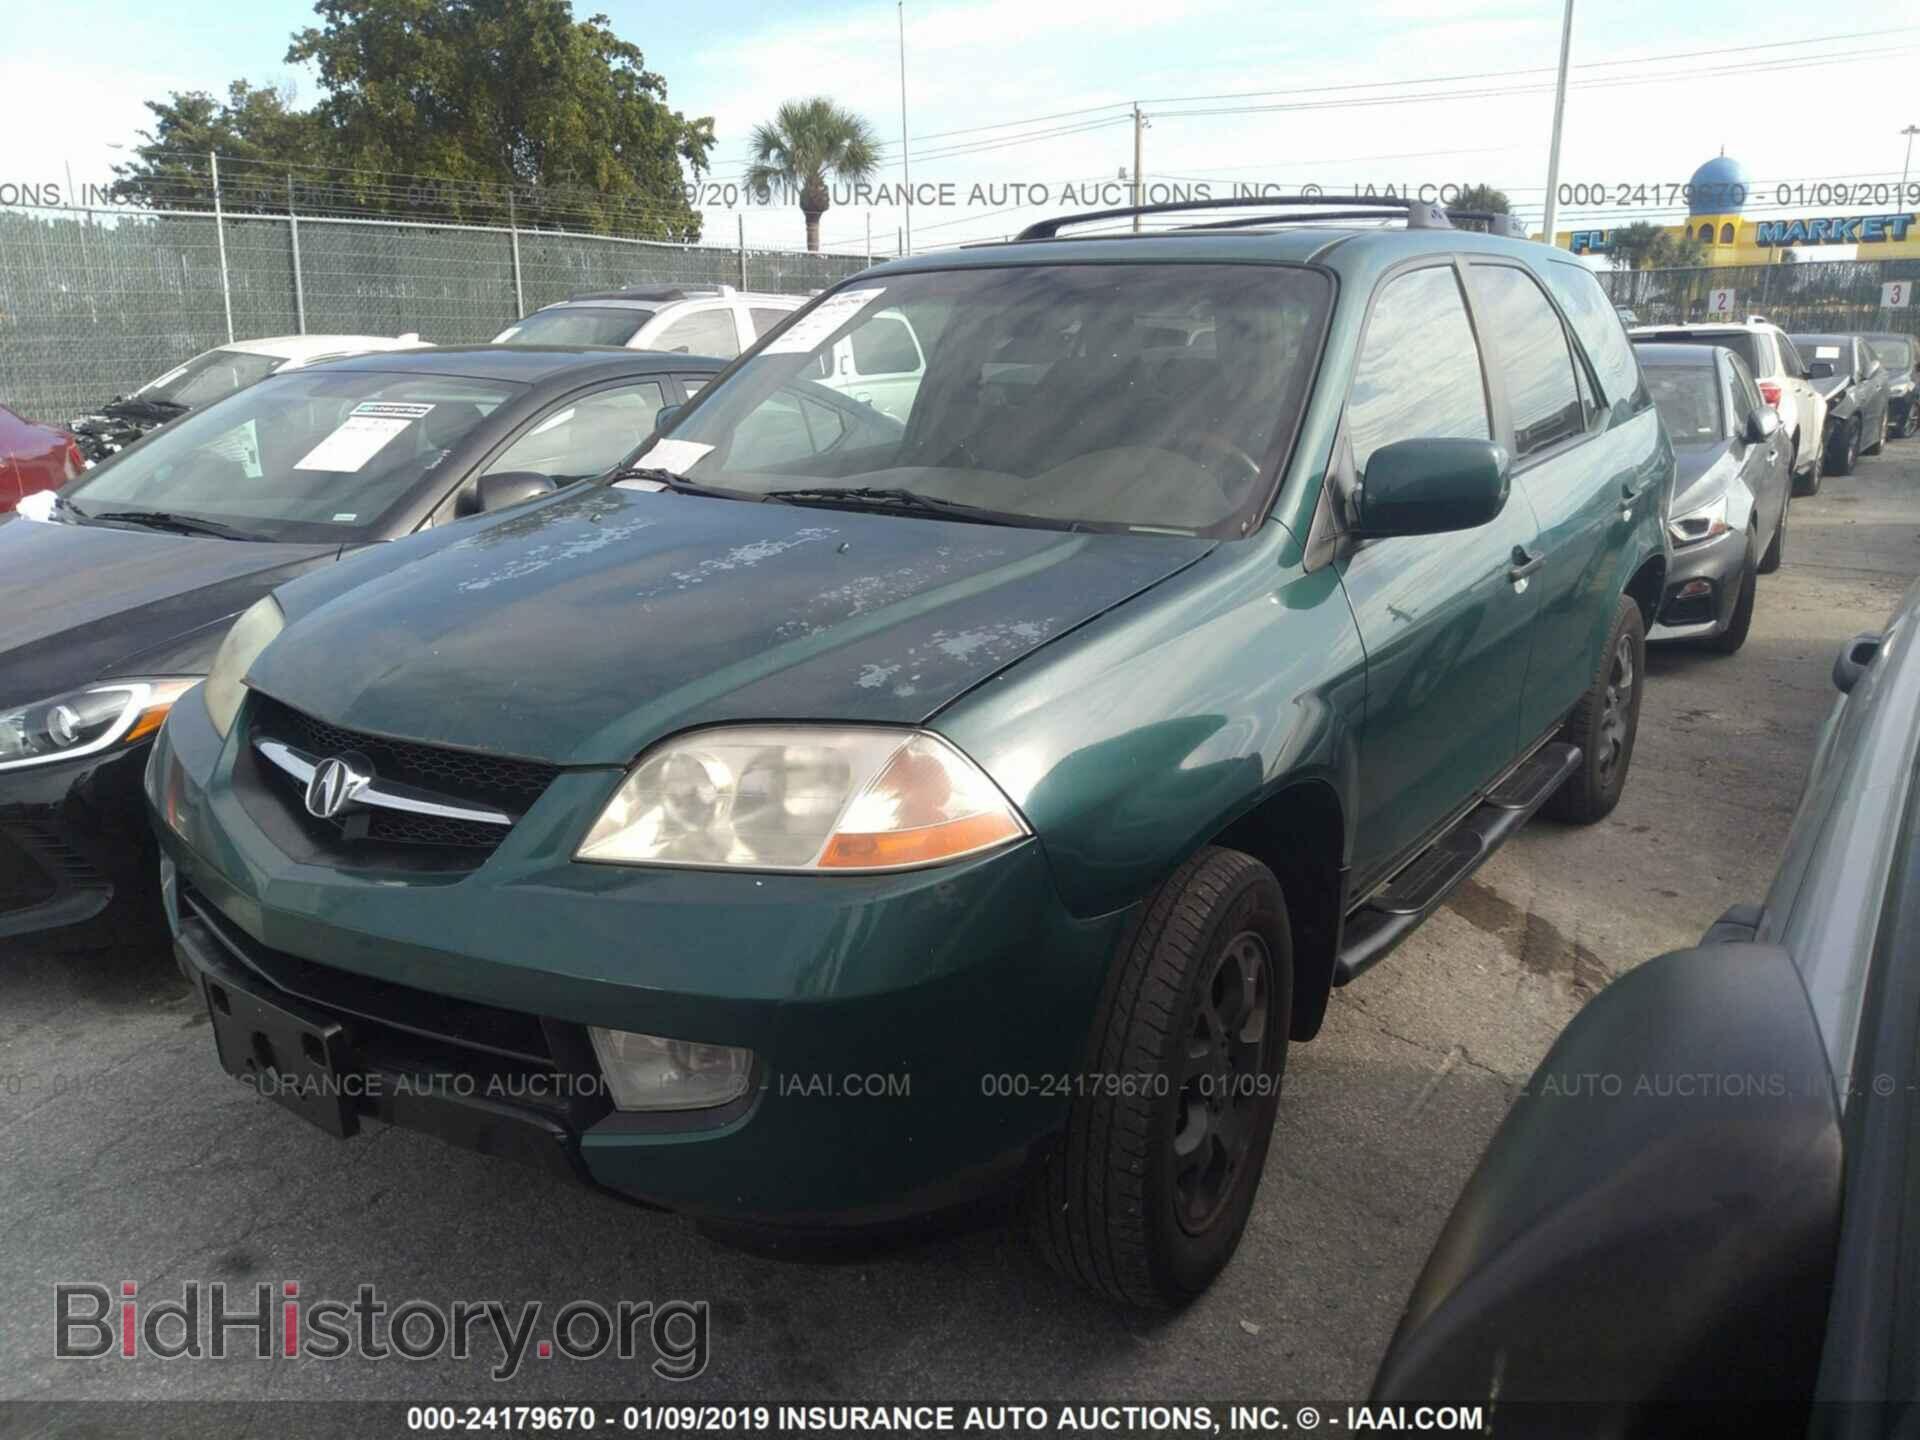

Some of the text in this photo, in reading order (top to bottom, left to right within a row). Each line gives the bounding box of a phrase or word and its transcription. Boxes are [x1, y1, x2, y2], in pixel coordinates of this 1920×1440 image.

[1755, 213, 1916, 248] MARKET
[1717, 292, 1727, 310] 2
[1890, 285, 1901, 305] 3
